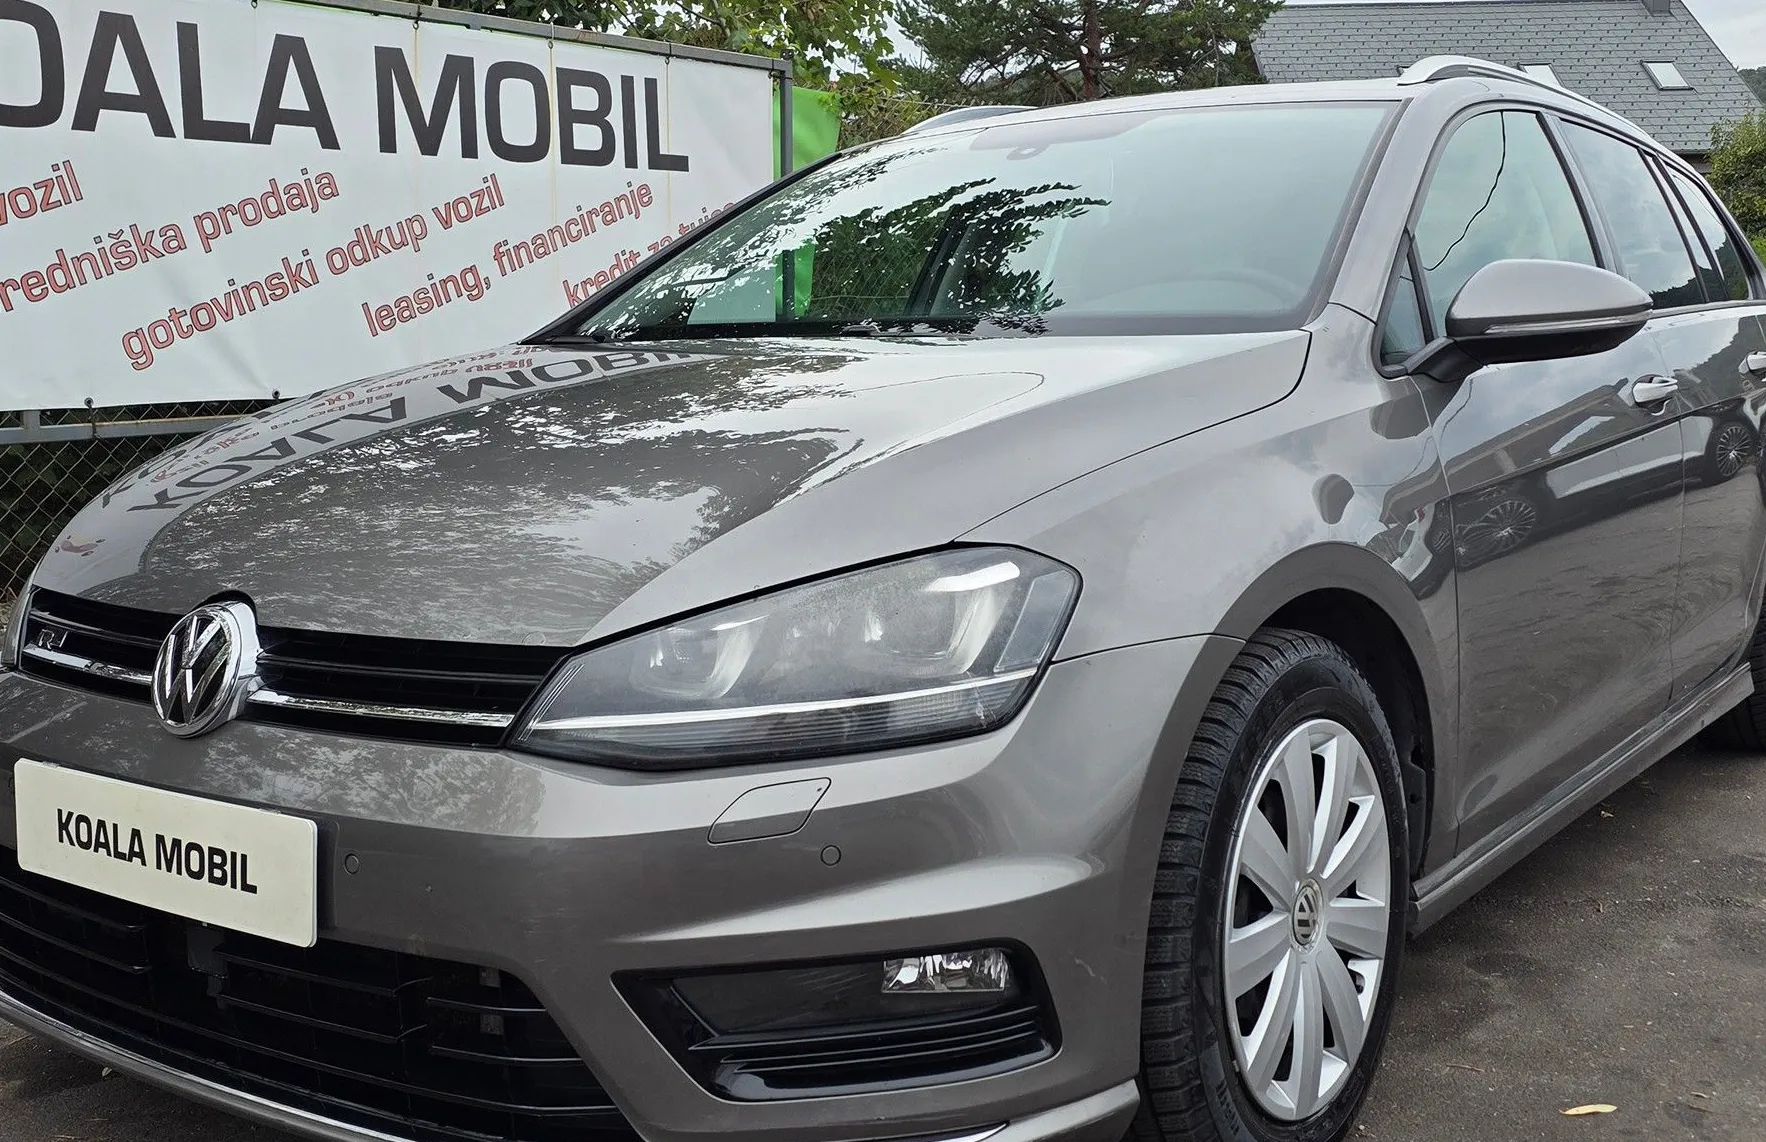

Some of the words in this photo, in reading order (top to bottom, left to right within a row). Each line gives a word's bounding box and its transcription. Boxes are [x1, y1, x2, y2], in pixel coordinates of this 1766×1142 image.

[374, 45, 690, 172] MOBIL
[121, 249, 320, 371] gotovinski
[325, 213, 428, 276] odkup
[432, 173, 505, 231] vozil
[193, 168, 340, 254] prodaja
[361, 264, 491, 337] leasing,
[493, 181, 653, 277] financiranje
[57, 808, 147, 866] KOALA
[155, 834, 258, 894] MOBIL
